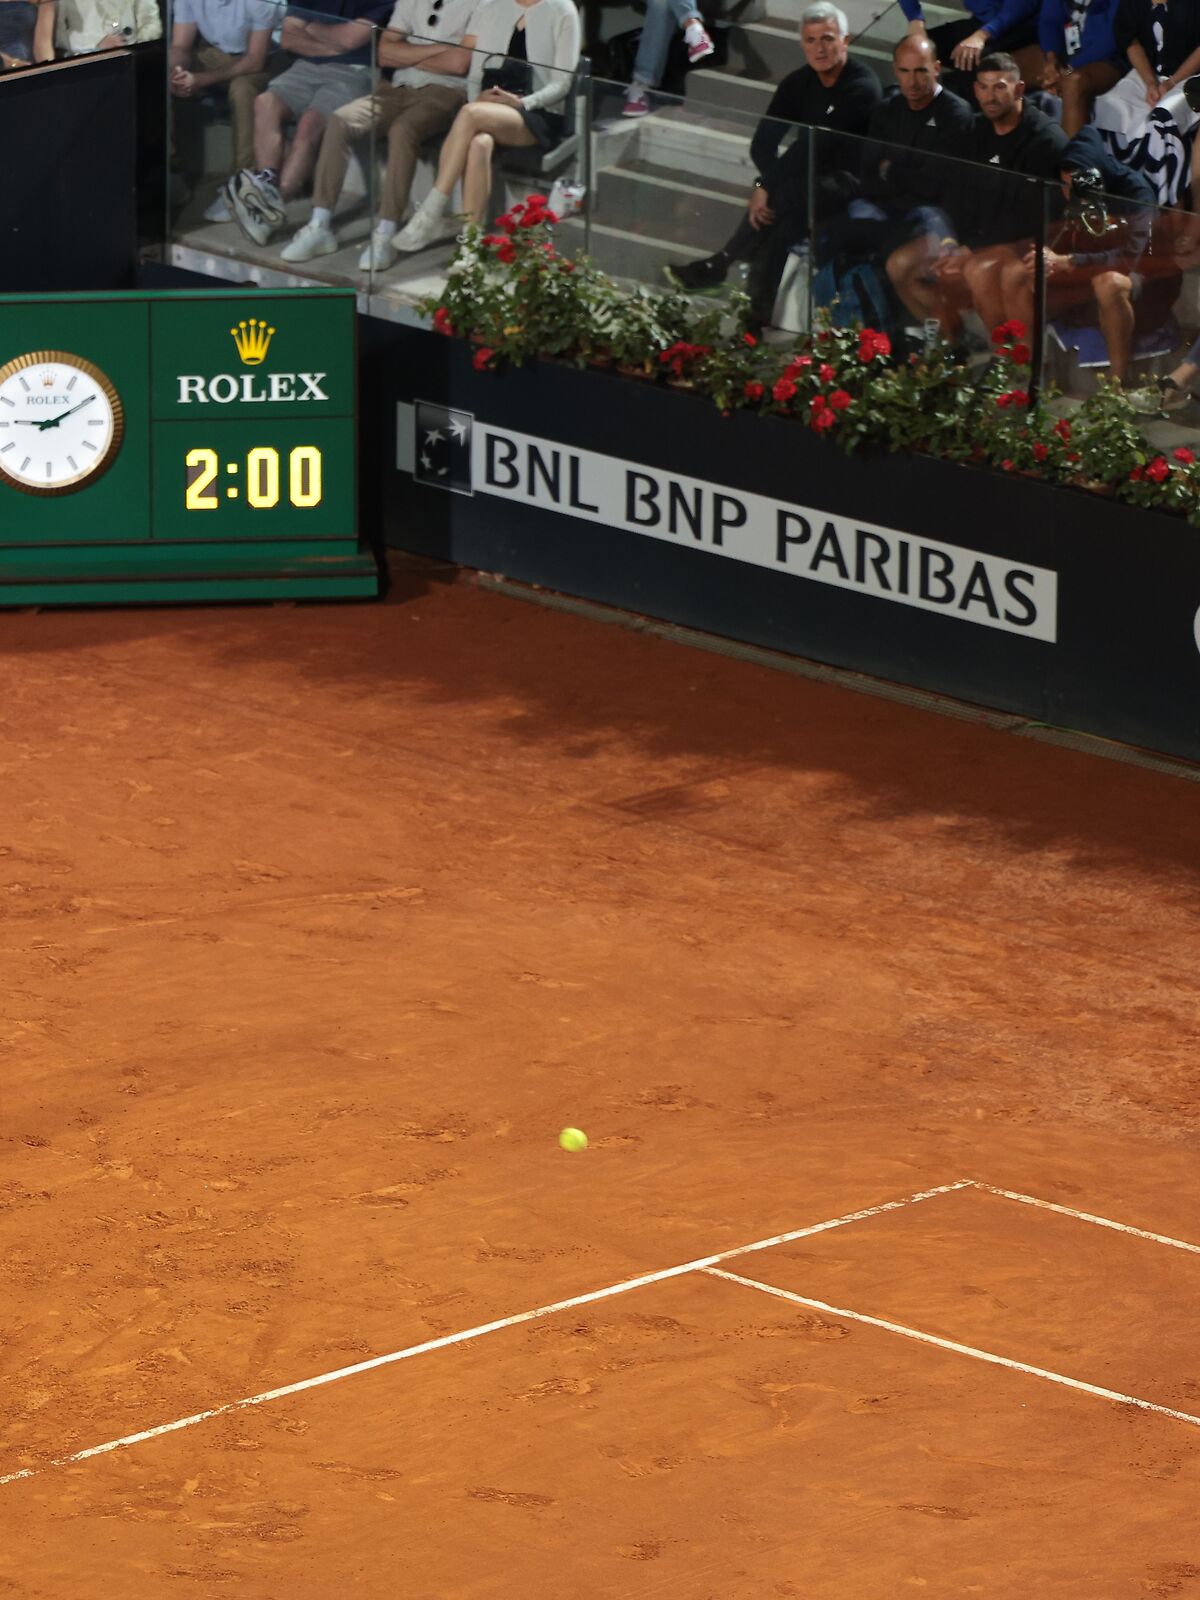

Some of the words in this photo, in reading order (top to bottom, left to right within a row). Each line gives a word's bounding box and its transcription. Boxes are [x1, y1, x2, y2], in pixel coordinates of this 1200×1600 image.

[26, 395, 70, 405] ROLEX
[177, 372, 329, 403] ROLEX
[185, 446, 322, 510] 2:00
[484, 433, 599, 514] BNL
[624, 469, 749, 547] BNP
[775, 508, 1039, 628] PARIBAS
